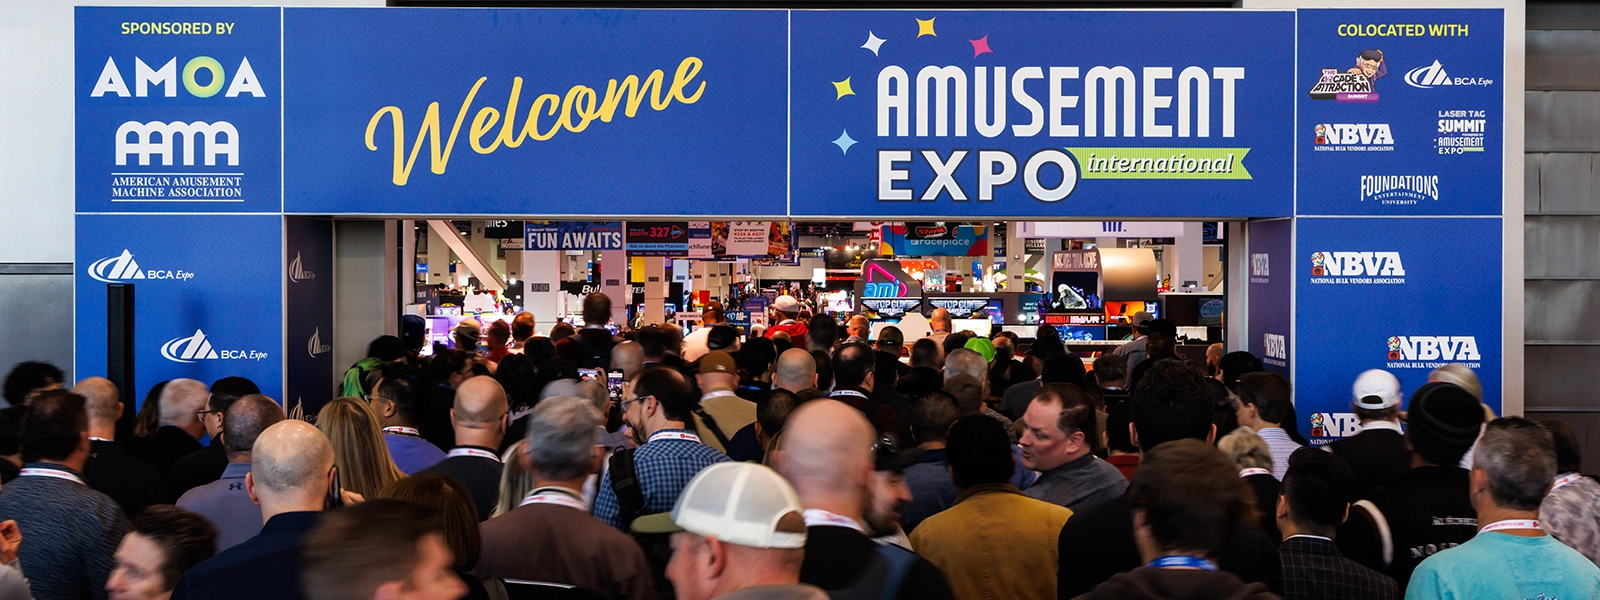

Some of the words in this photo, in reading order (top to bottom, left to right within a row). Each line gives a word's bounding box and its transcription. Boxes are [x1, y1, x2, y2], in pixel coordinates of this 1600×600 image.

[121, 22, 213, 35] SPONSORED
[215, 22, 235, 35] BY
[1337, 24, 1425, 37] COLOCATED
[1429, 24, 1469, 37] WITH
[90, 56, 267, 98] AMOA
[1454, 77, 1477, 86] BCA
[1477, 77, 1493, 87] Expo
[1313, 82, 1370, 92] ATTRACTION
[877, 65, 1245, 138] AMUSEMENT
[1438, 110, 1467, 118] LASER
[1468, 110, 1486, 118] TAG
[365, 56, 707, 186] Welcome
[1437, 119, 1486, 133] SUMMIT
[1323, 123, 1395, 145] NBVA
[115, 121, 240, 166] AAMA
[1438, 137, 1484, 147] AMUSEMENT
[1438, 147, 1464, 155] EXPO
[1086, 152, 1234, 174] international
[112, 177, 170, 187] AMERICAN
[172, 177, 242, 187] AMUSEMENT
[878, 149, 1078, 202] EXPO
[112, 187, 165, 197] MACHINE
[168, 187, 242, 197] ASSOCIATION
[1360, 175, 1439, 202] FOUNDATIONS
[1374, 192, 1425, 200] ENTERTAINMENT
[649, 227, 670, 237] 327
[918, 226, 946, 235] Stern
[527, 232, 558, 249] FUN
[562, 232, 621, 249] AWAITS
[1322, 251, 1405, 276] NBVA
[148, 270, 174, 279] BCA
[176, 270, 194, 281] Expo
[863, 280, 899, 298] ami
[876, 300, 891, 309] TOP
[891, 300, 907, 309] GUN
[943, 300, 958, 309] TOP
[959, 300, 974, 309] GUN
[1045, 316, 1069, 324] GODZILLA
[1265, 333, 1286, 359] NBVA
[1397, 336, 1481, 361] NBVA
[221, 350, 247, 360] BCA
[249, 350, 268, 361] Expo
